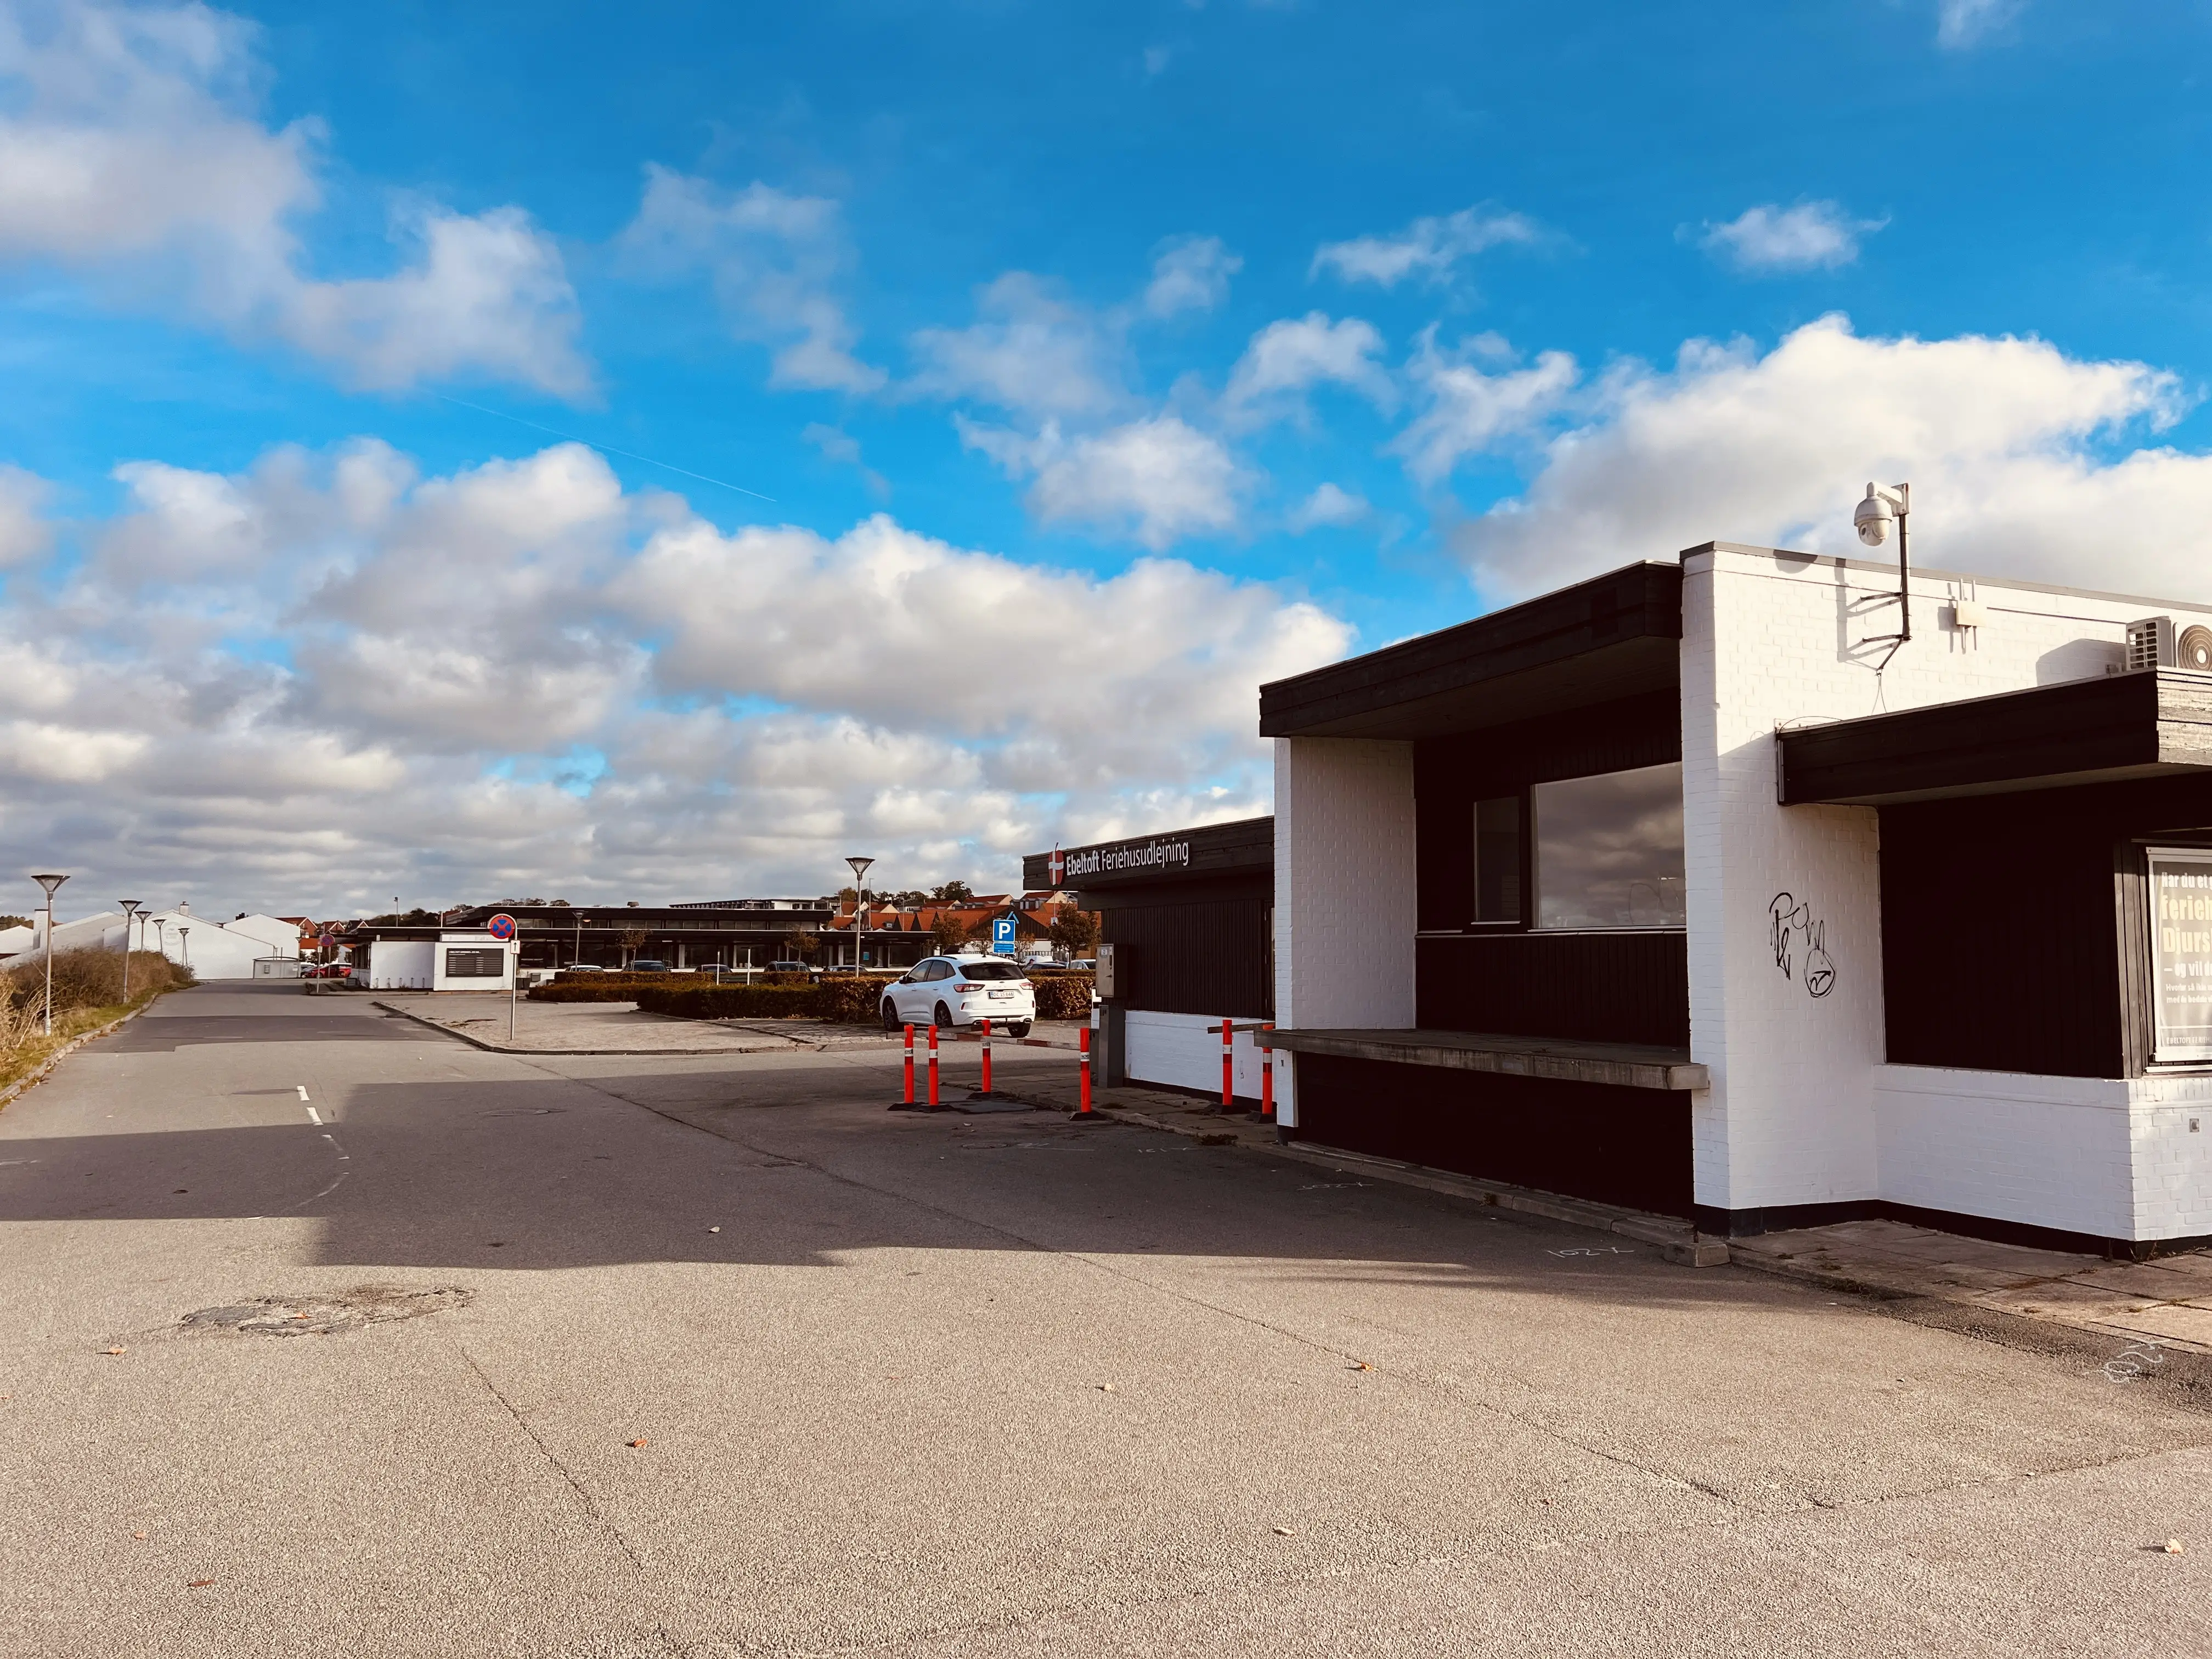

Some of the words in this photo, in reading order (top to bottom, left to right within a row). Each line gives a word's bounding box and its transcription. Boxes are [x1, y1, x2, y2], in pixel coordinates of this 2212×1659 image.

[1066, 850, 1100, 876] Ebeltoft
[1102, 837, 1189, 871] Feriehusudlejning
[2162, 872, 2179, 888] Har
[2181, 873, 2195, 888] du
[2197, 874, 2208, 889] et
[998, 922, 1011, 939] P
[2175, 962, 2186, 978] og
[2188, 960, 2203, 977] vil
